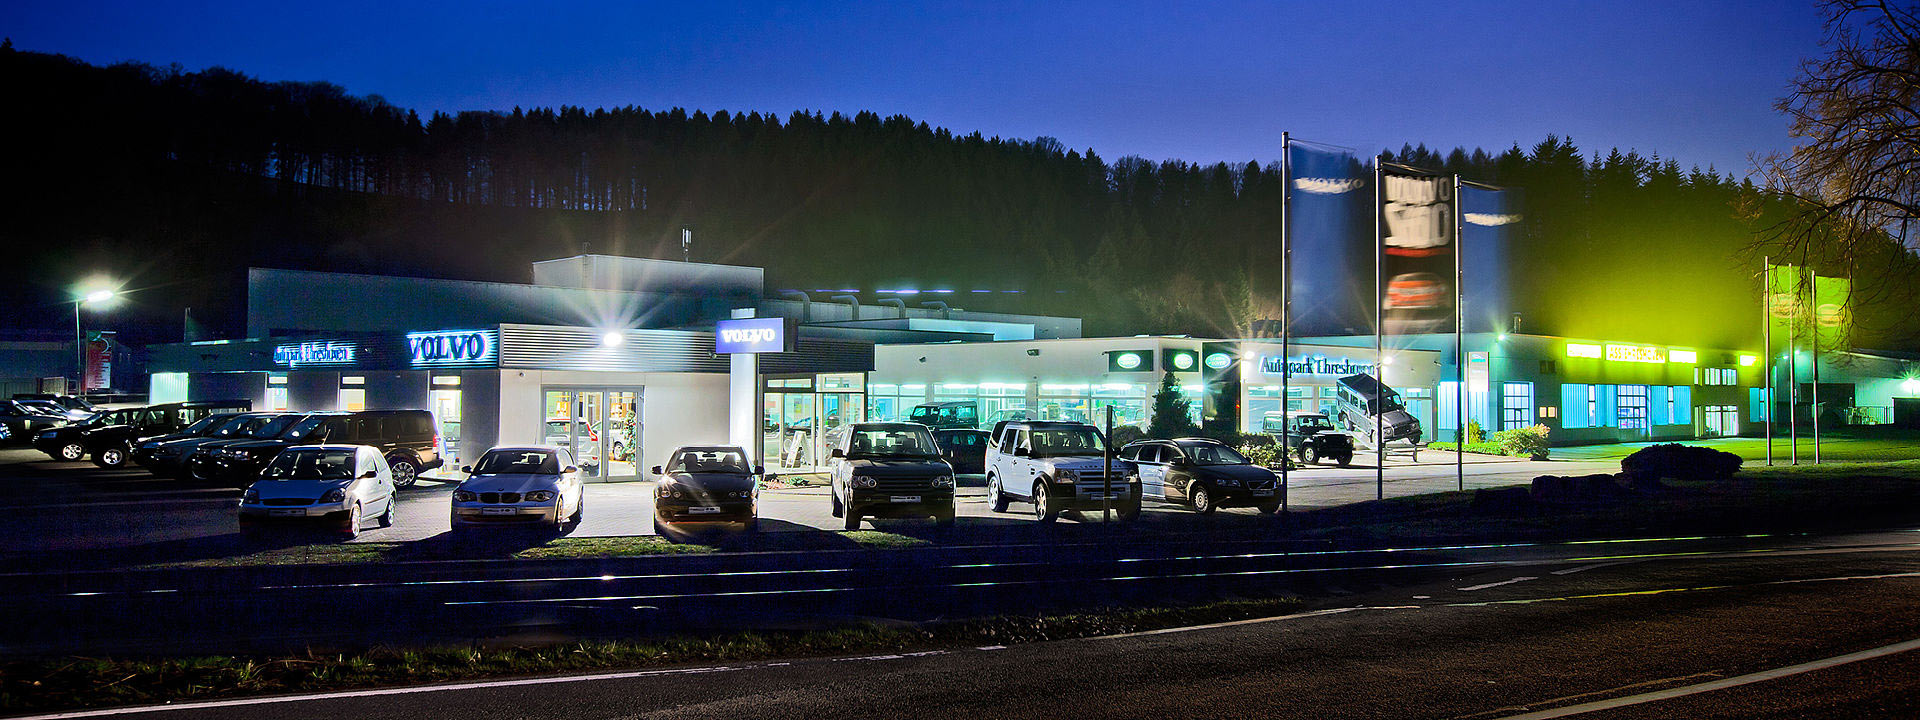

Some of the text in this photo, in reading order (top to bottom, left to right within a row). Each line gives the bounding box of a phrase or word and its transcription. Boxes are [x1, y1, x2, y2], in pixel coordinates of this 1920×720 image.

[721, 328, 776, 343] VOLVO
[408, 334, 485, 360] VOLVO
[1260, 357, 1313, 378] Autpark
